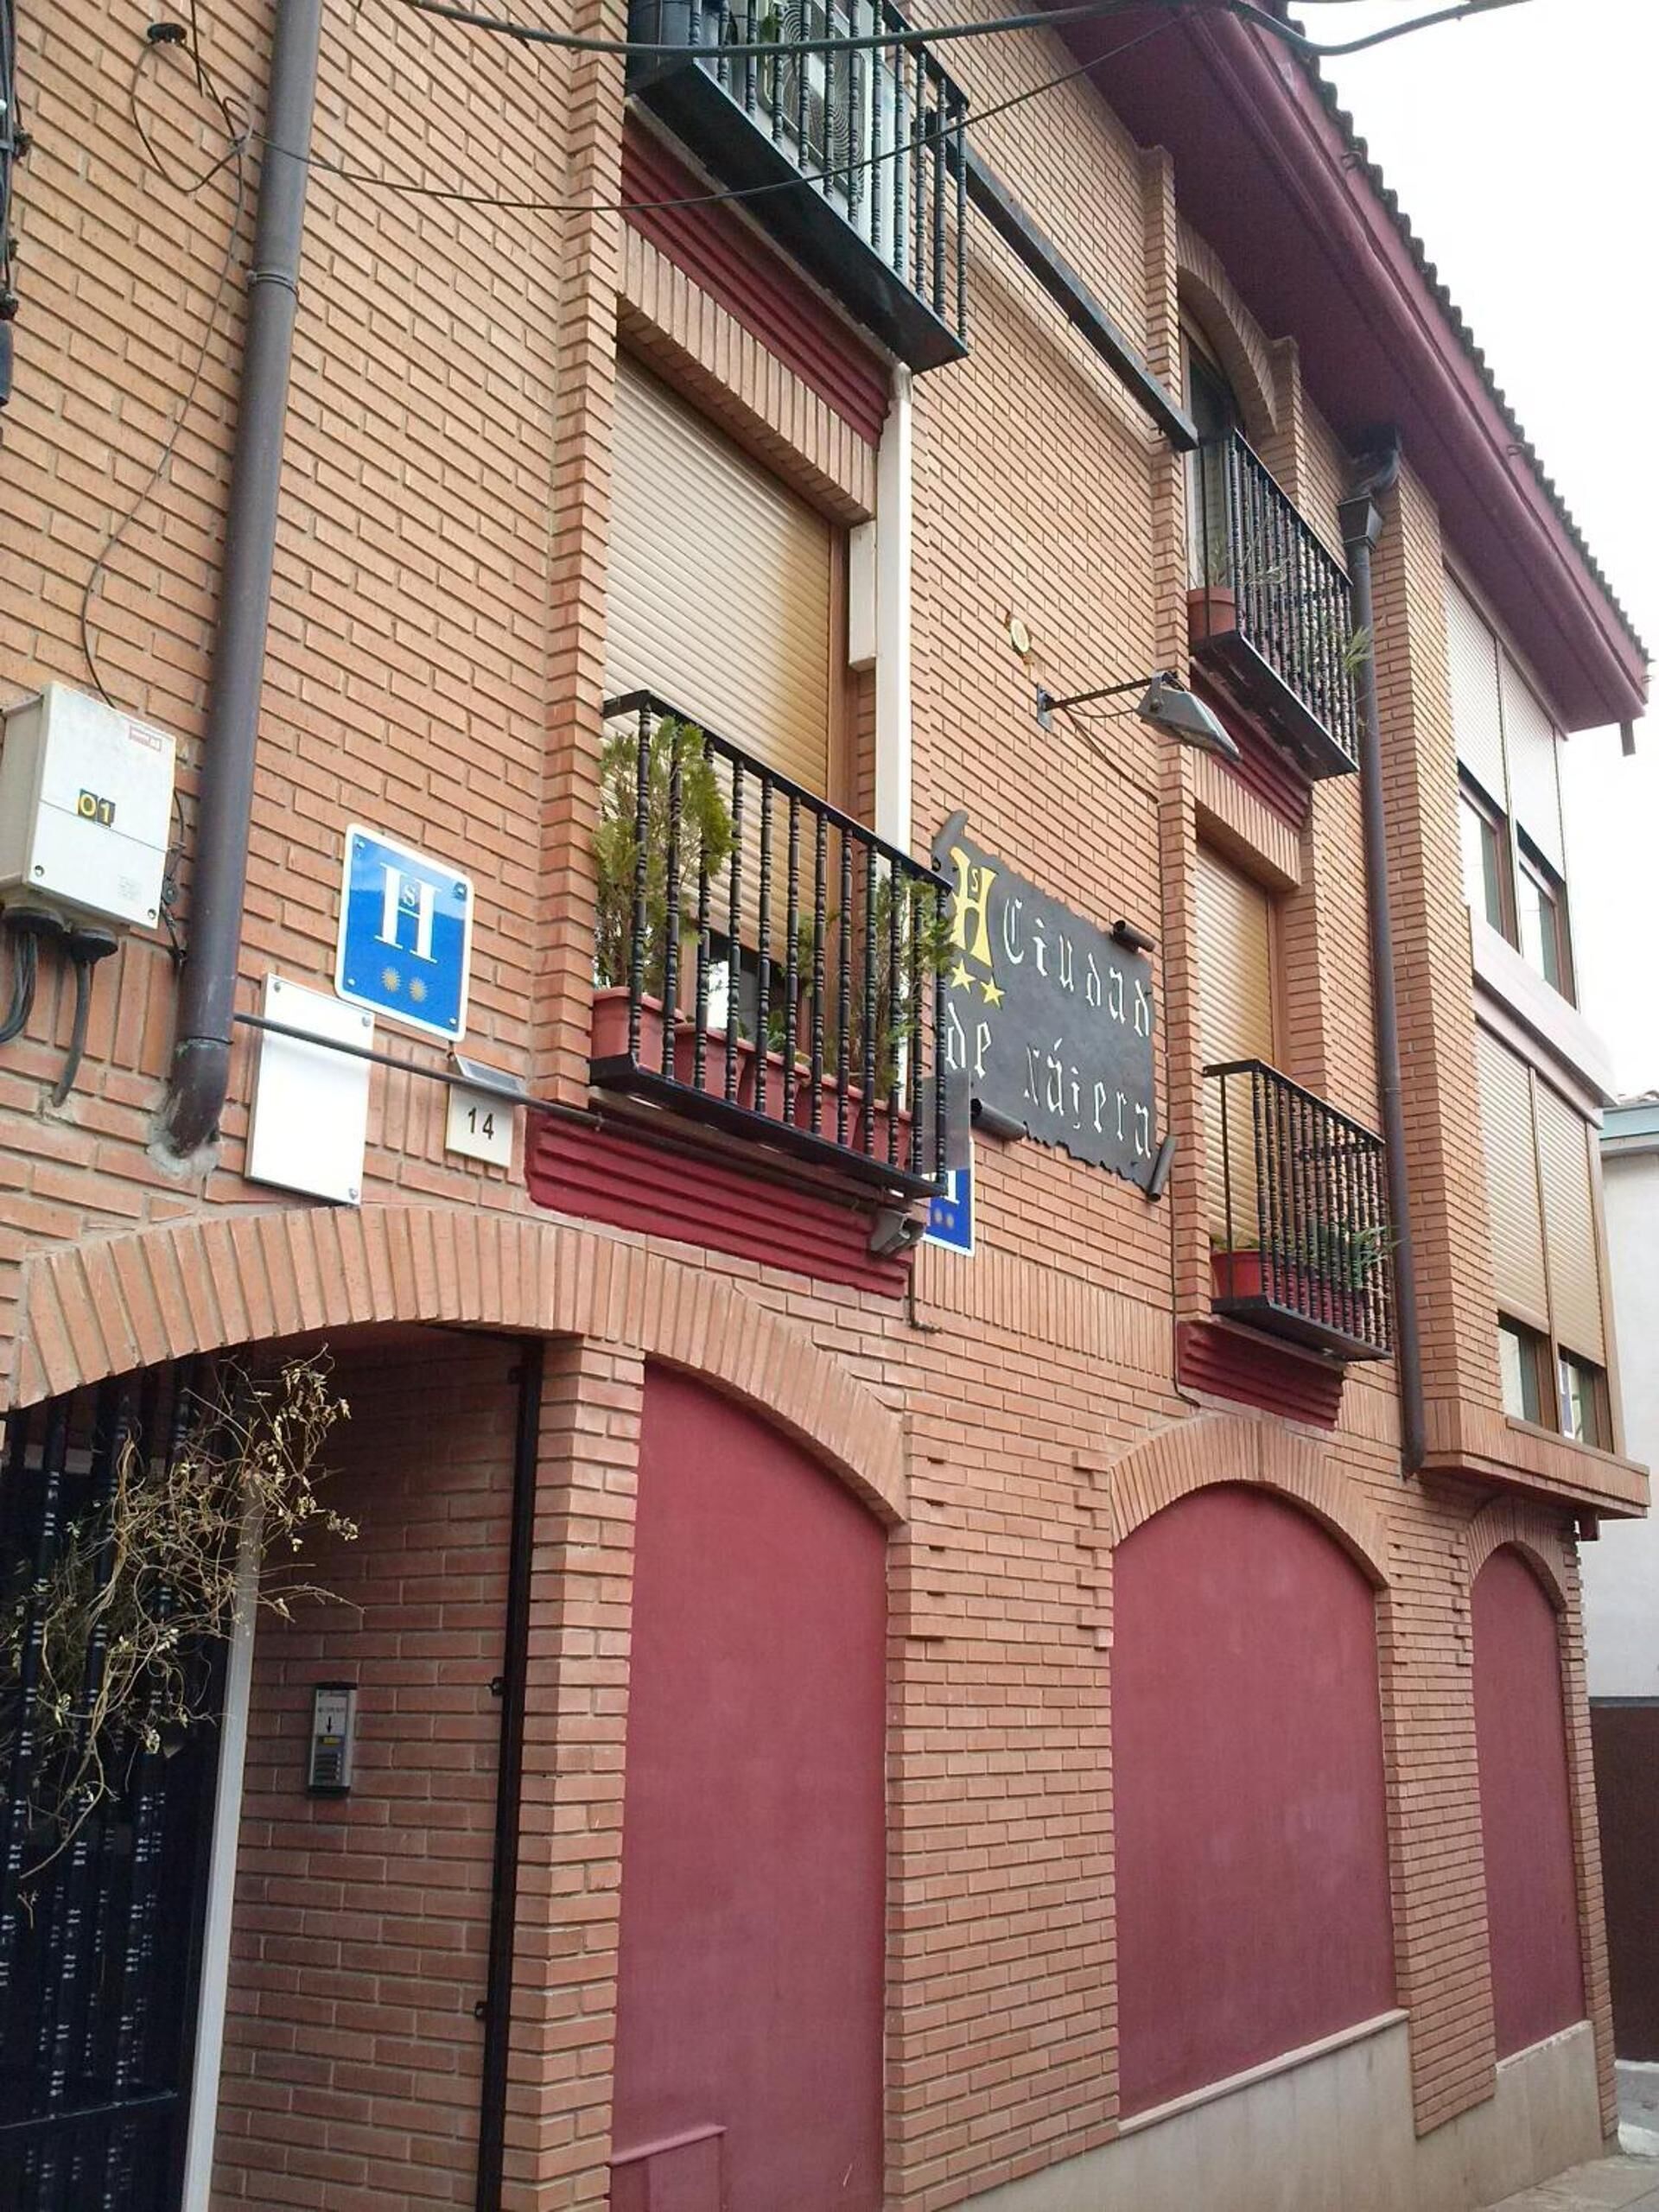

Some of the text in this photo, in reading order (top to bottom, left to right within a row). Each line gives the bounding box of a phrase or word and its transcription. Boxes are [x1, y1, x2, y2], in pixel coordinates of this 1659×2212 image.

[77, 791, 112, 825] 01
[374, 862, 442, 963] H
[950, 847, 996, 967] H
[1003, 897, 1150, 1037] Ciudad
[945, 1001, 992, 1079] de
[468, 1107, 494, 1141] 14
